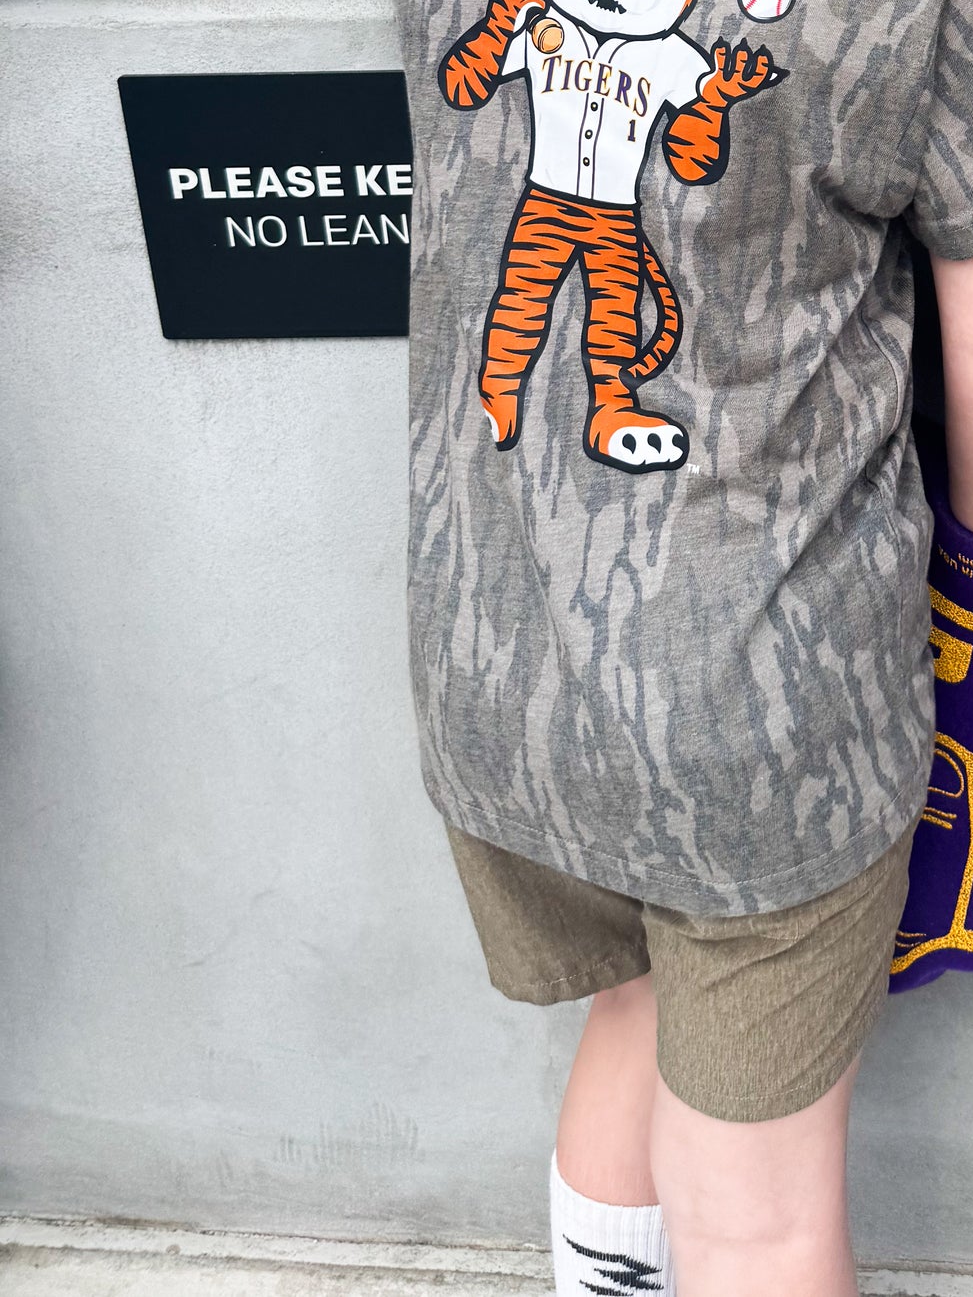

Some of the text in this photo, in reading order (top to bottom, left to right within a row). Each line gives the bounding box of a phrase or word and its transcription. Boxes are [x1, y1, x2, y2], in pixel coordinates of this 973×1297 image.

[541, 54, 651, 118] TIGERS
[627, 119, 636, 142] 1
[168, 166, 344, 200] PLEASE
[225, 213, 410, 247] NO LEAN
[961, 566, 973, 580] in
